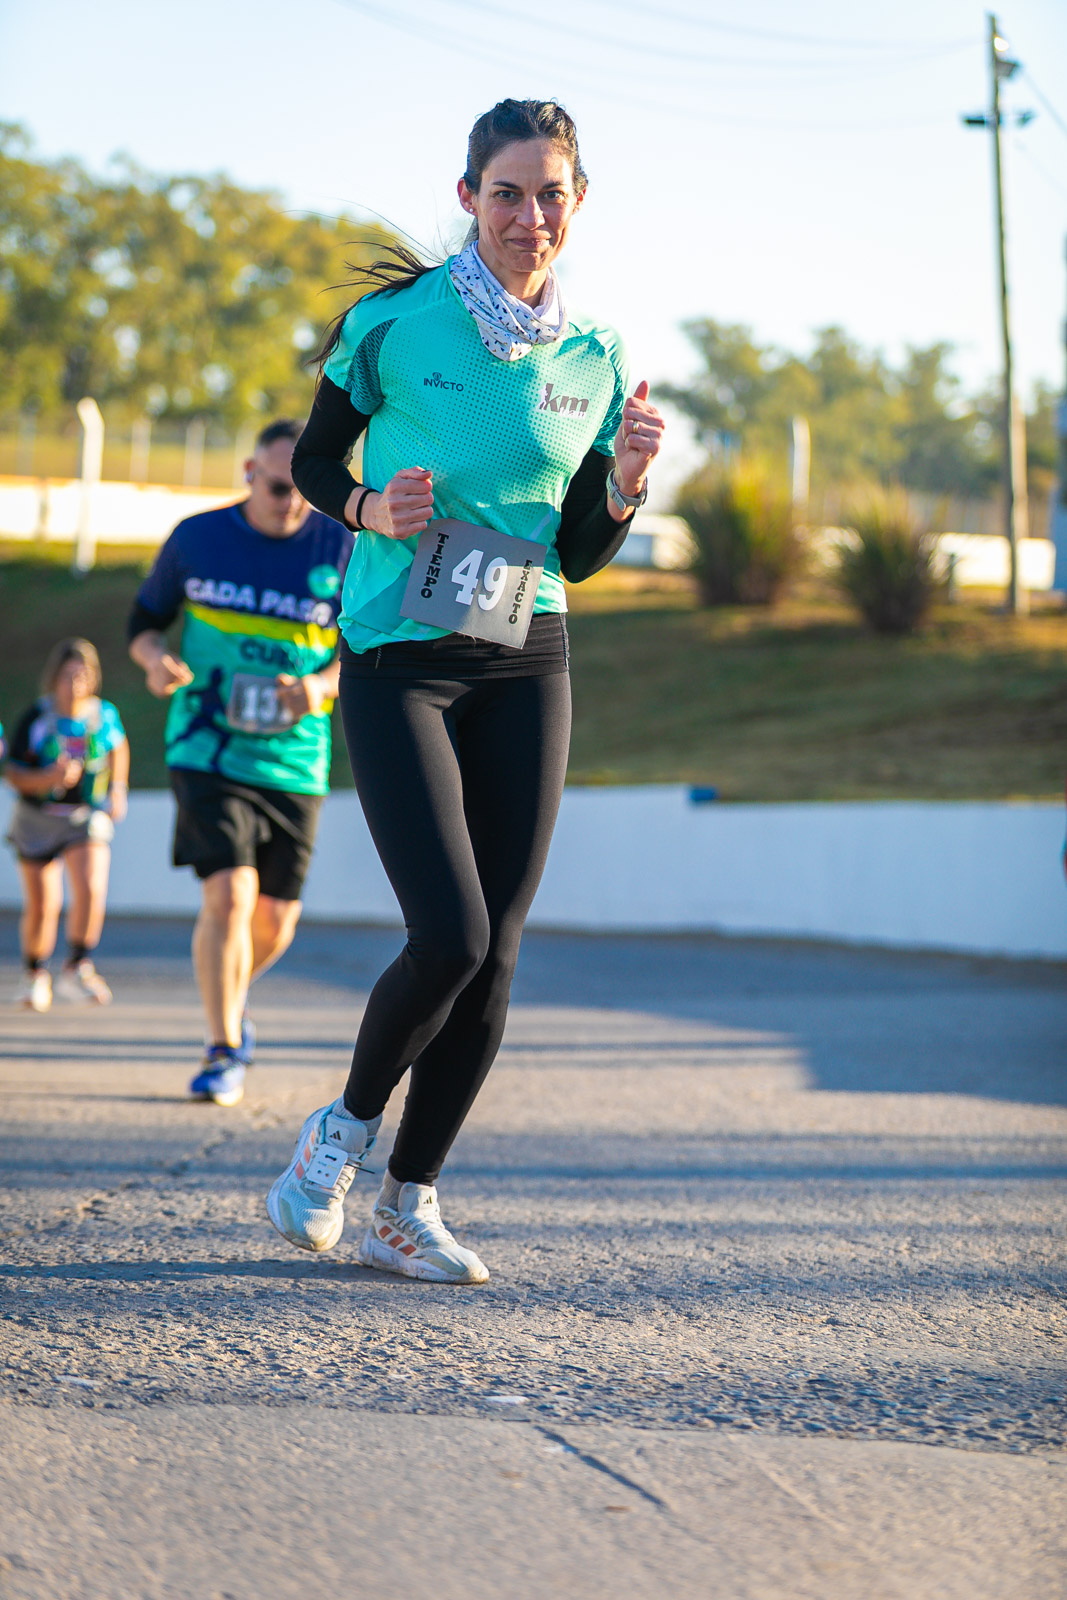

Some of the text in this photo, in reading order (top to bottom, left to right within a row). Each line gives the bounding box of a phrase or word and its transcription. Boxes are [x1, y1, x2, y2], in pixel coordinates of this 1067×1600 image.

[423, 377, 464, 392] INVICTO
[539, 382, 590, 413] km
[420, 532, 450, 599] TIEMPO
[451, 548, 509, 611] 49
[184, 577, 256, 610] CADA
[508, 559, 533, 625] EXACTO
